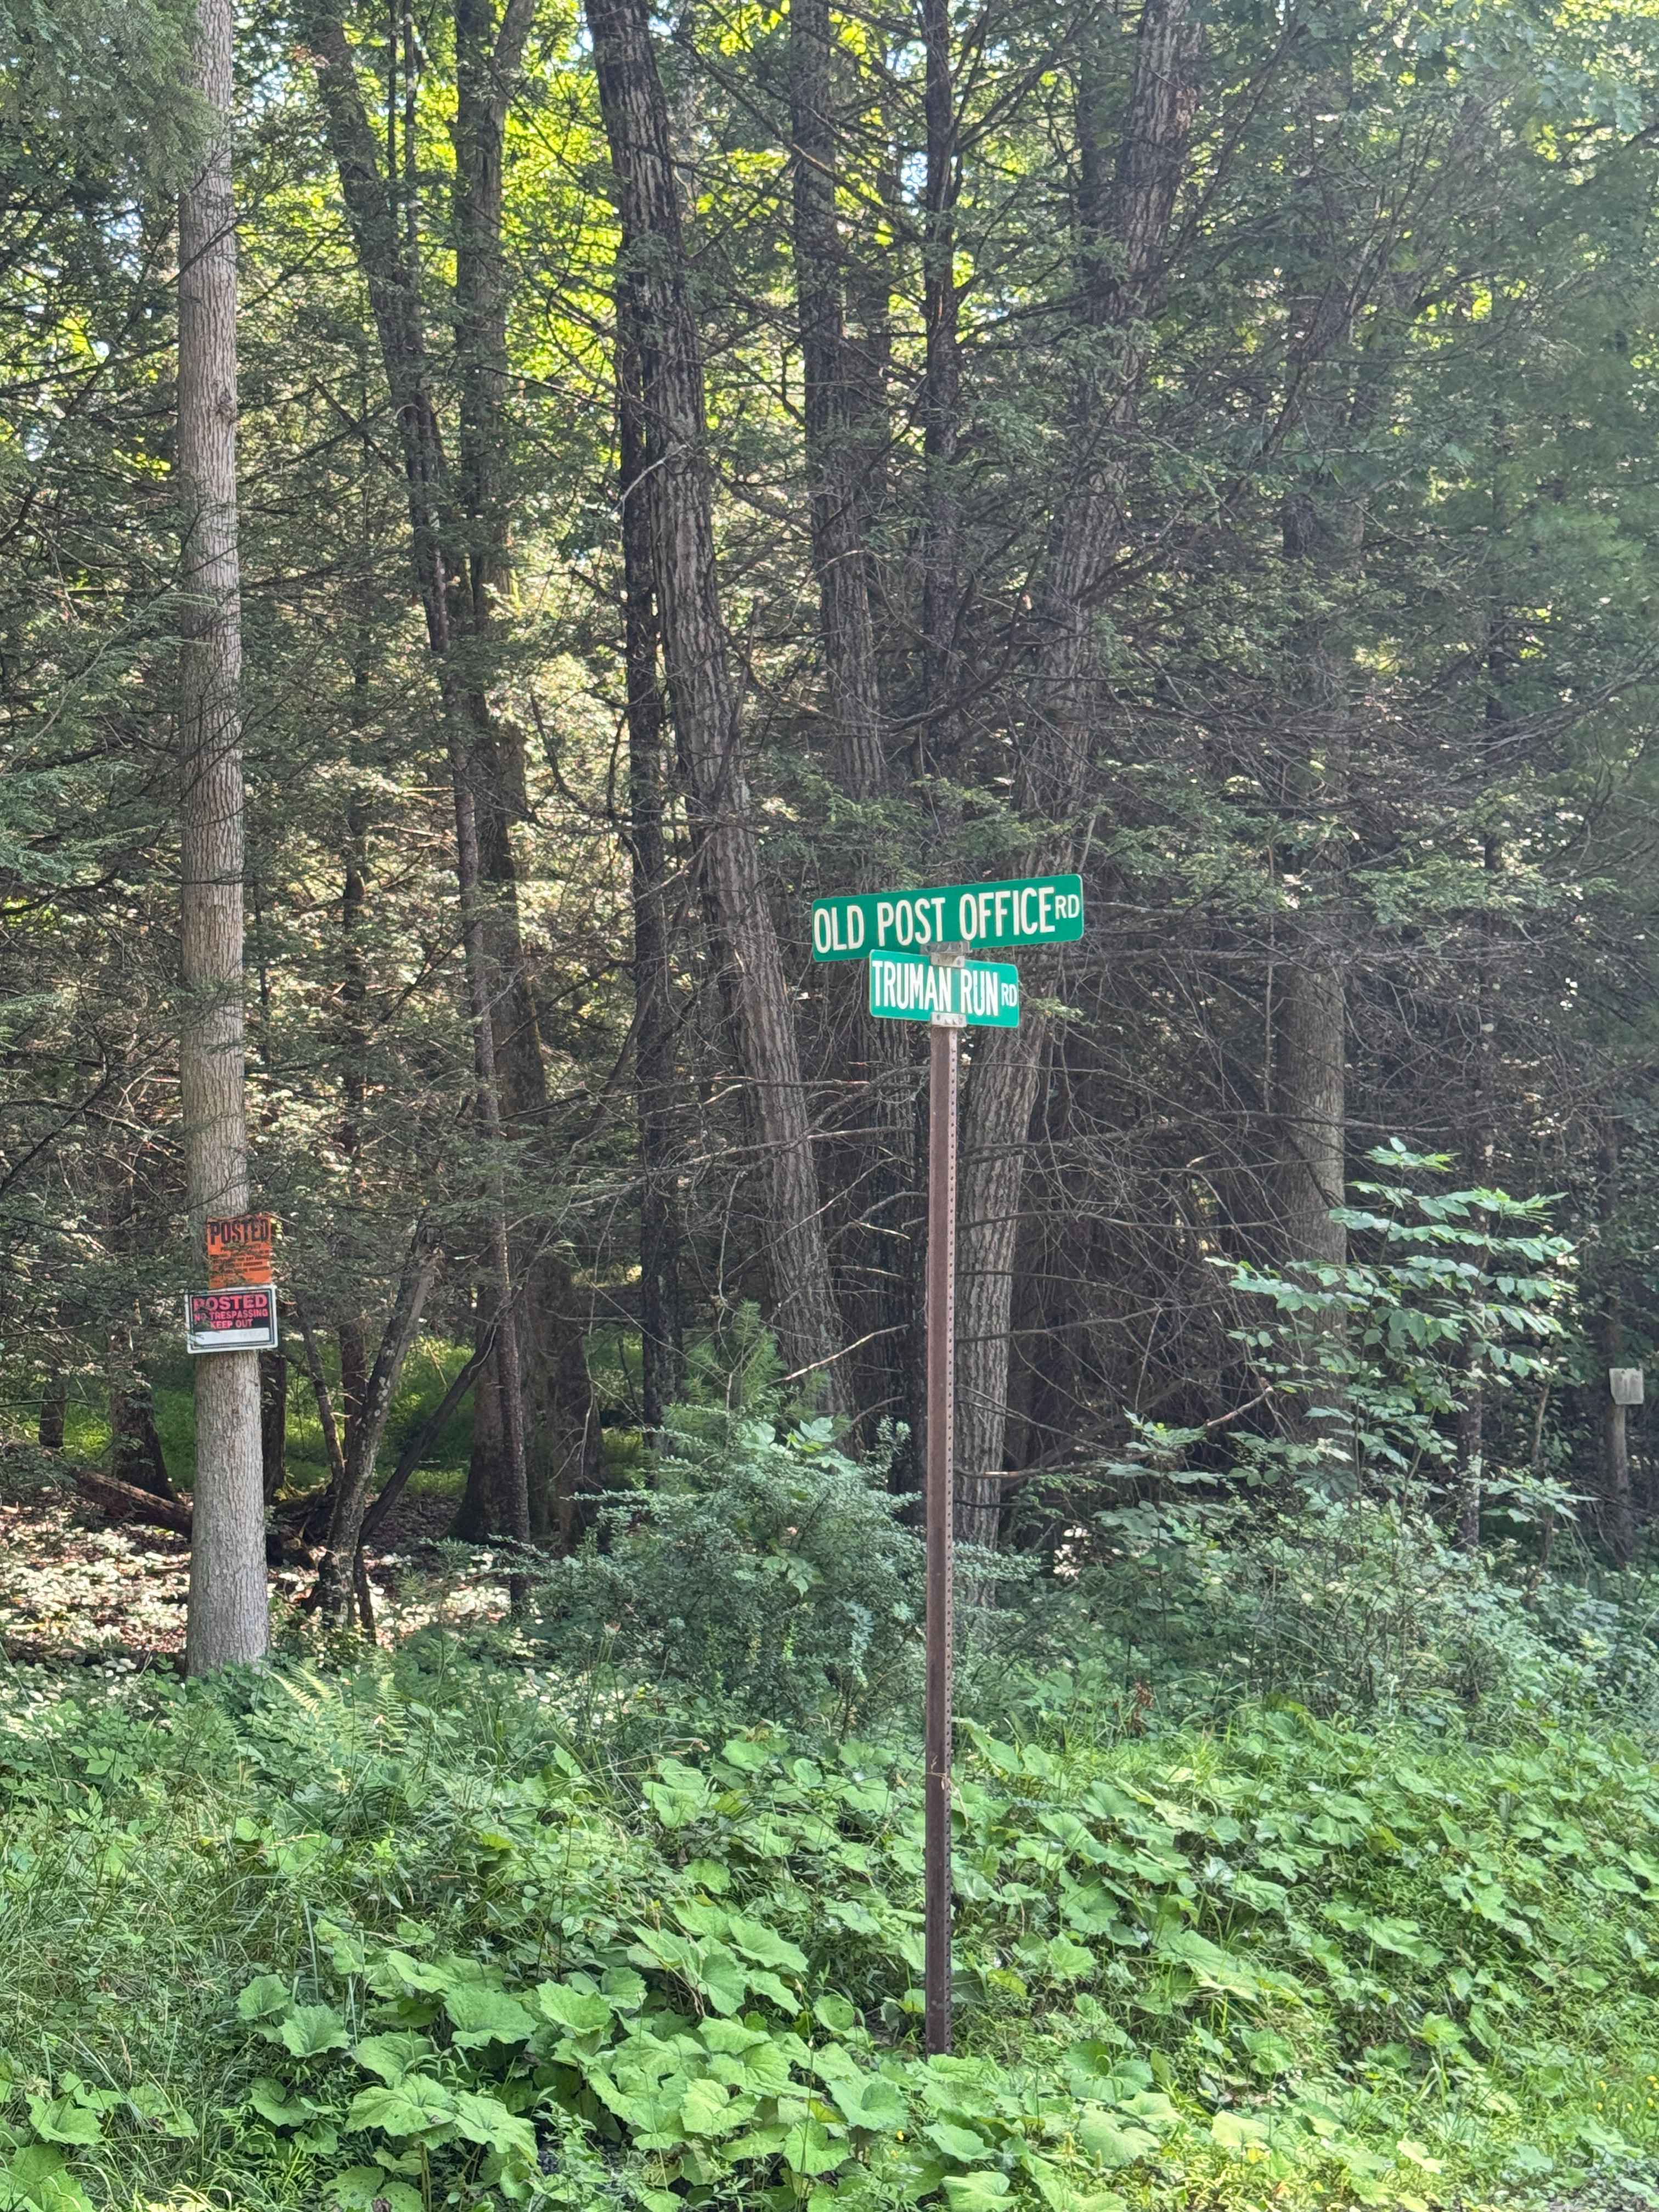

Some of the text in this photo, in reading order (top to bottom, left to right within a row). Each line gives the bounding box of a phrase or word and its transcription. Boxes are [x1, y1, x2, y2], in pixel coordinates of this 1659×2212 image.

[814, 887, 1080, 953] OLD POST OFFICE RD
[872, 961, 1018, 1016] TRUMAN RUN RD
[210, 1219, 268, 1245] POSTED
[193, 1294, 268, 1312] POSTED
[210, 1309, 268, 1320] TRESPASSING
[211, 1319, 253, 1330] KEEP OUT
